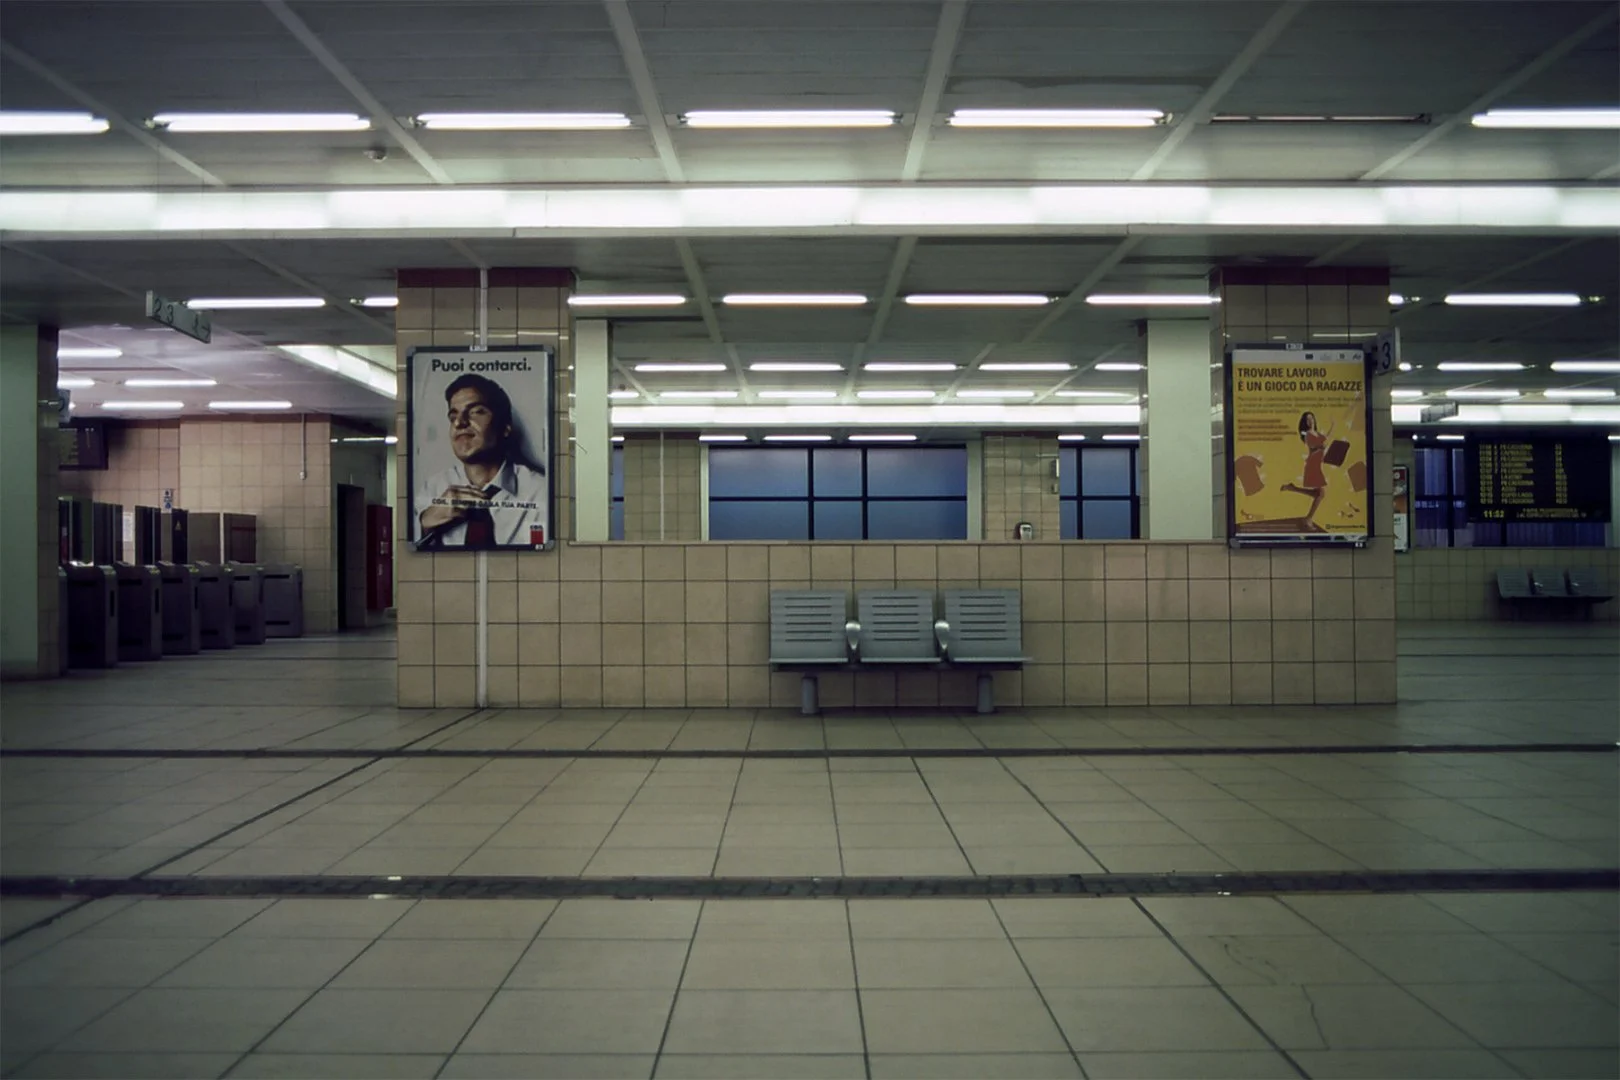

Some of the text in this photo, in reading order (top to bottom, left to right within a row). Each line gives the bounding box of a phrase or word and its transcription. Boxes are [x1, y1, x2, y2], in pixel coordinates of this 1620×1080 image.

[153, 298, 174, 324] 2 3
[1382, 342, 1391, 370] 3
[431, 357, 532, 372] Puoi contarci.
[1237, 367, 1327, 378] TROVARE LAVORO
[1237, 379, 1363, 392] È UN GIOCO DA RAGAZZE
[501, 501, 515, 509] TUA
